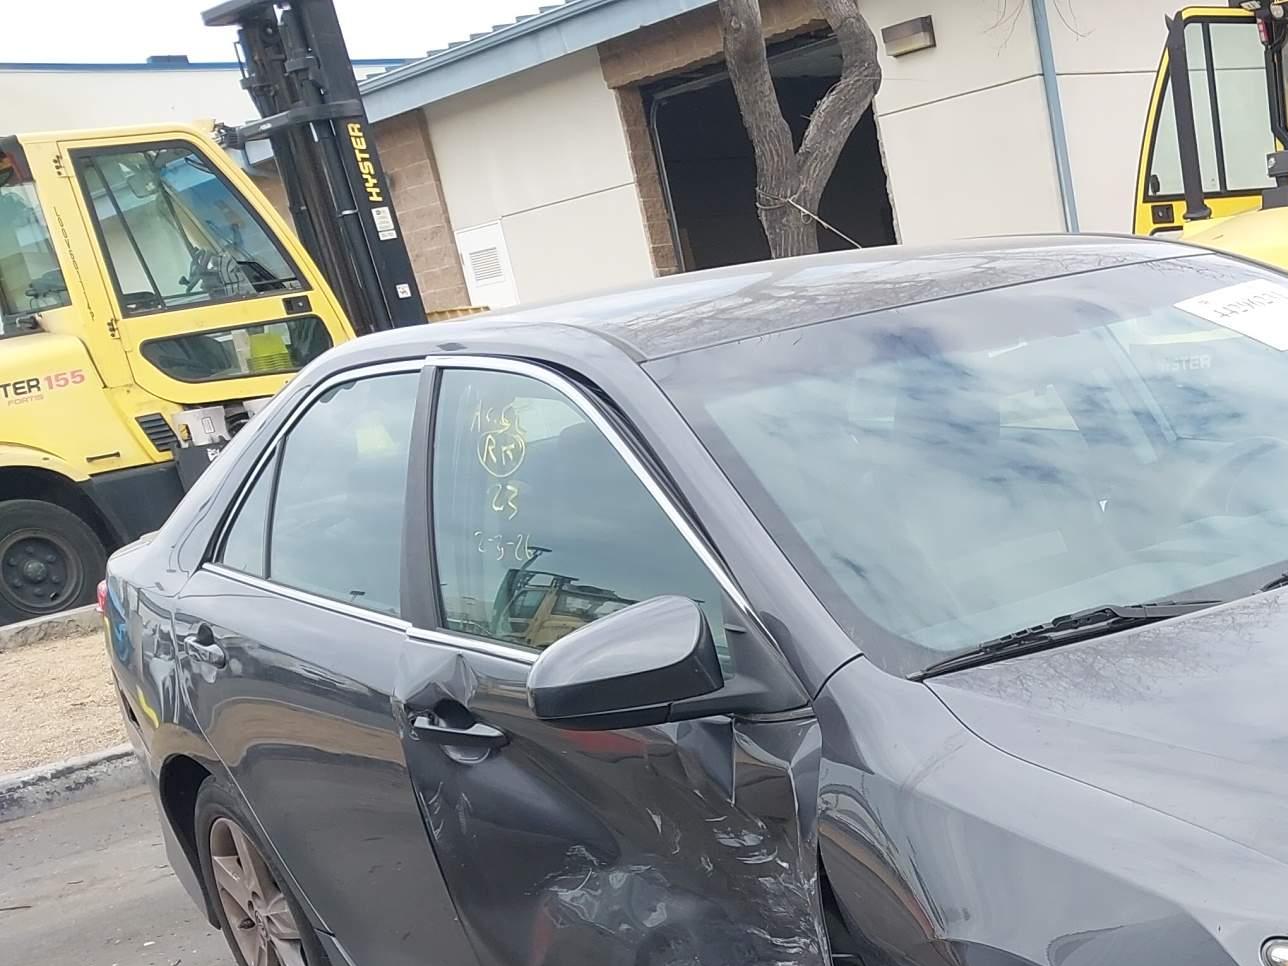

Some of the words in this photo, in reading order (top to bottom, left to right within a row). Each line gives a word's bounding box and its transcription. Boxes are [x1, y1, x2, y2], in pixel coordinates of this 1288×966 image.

[347, 122, 383, 202] HYSTER
[43, 369, 86, 390] 155
[8, 393, 44, 406] FORTIS
